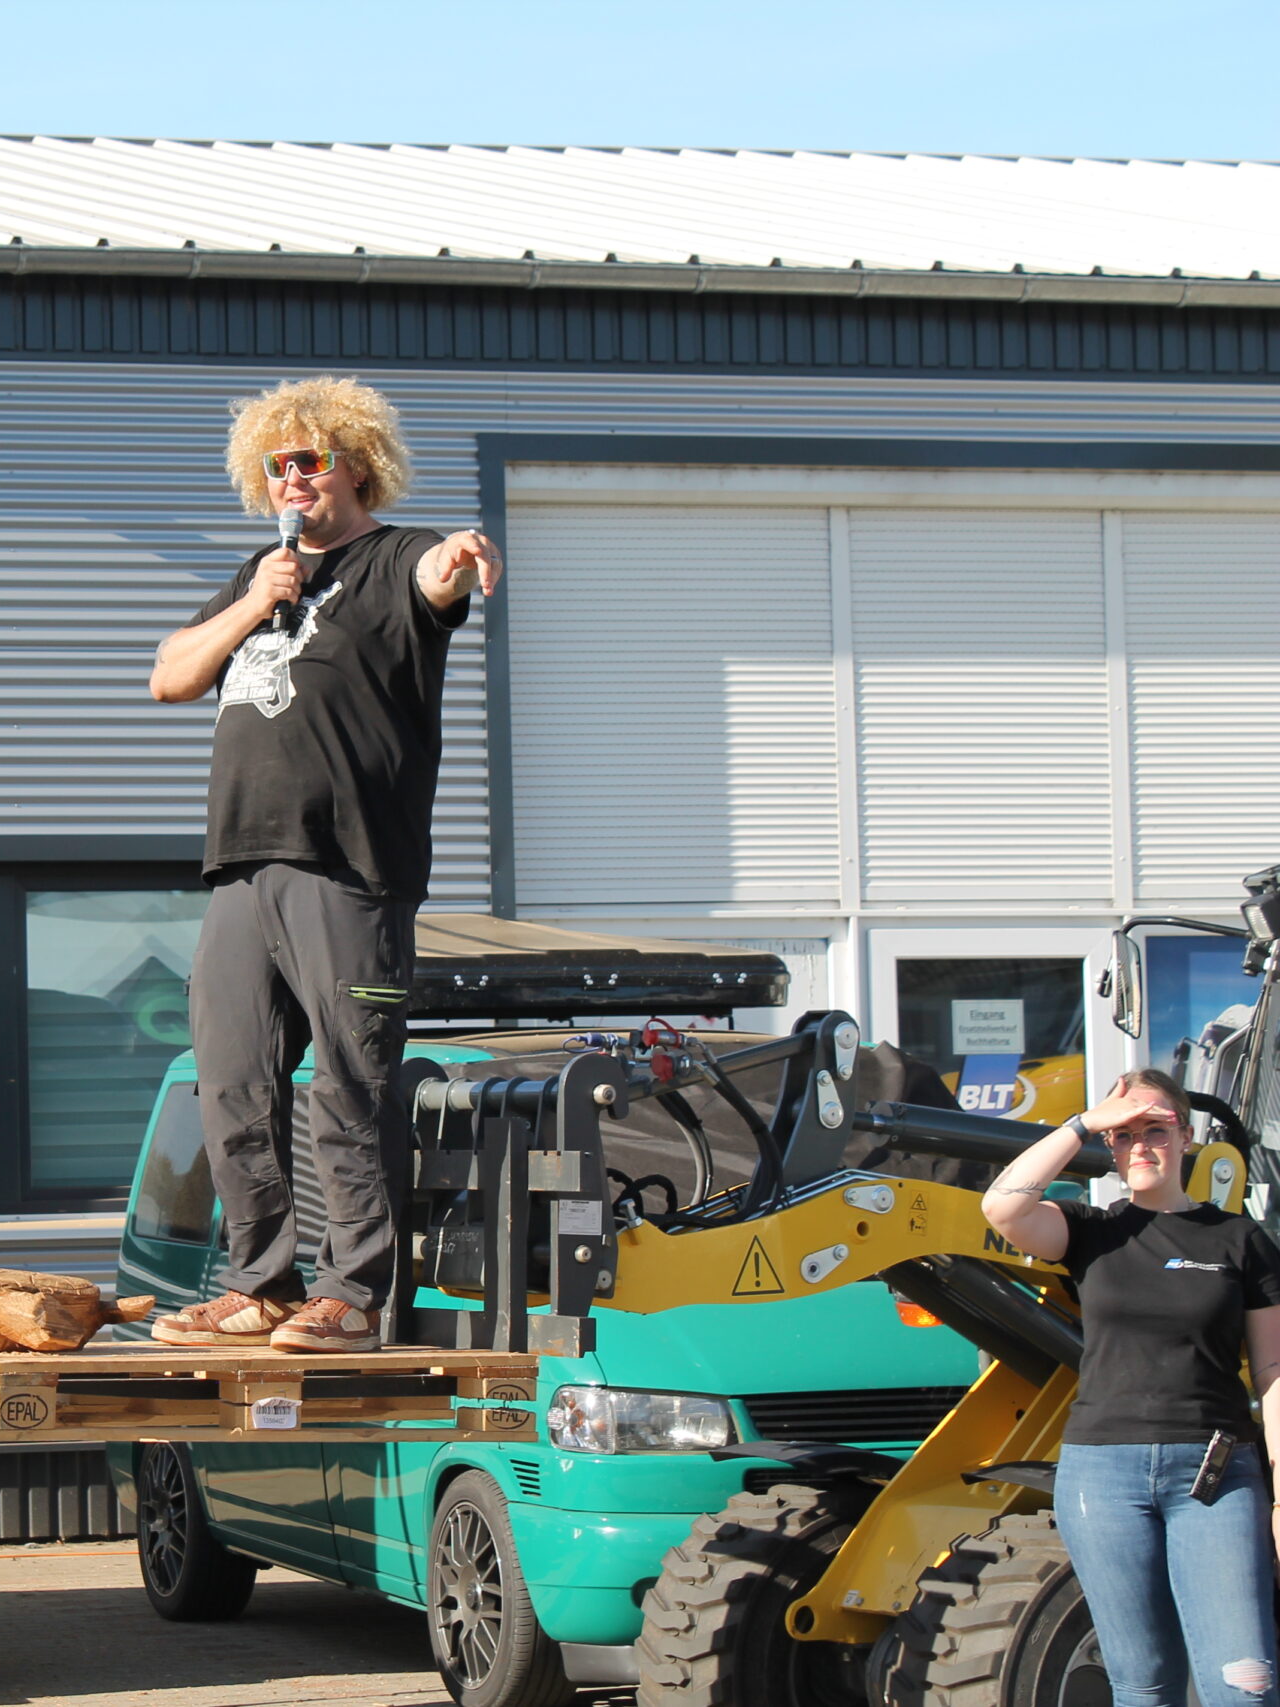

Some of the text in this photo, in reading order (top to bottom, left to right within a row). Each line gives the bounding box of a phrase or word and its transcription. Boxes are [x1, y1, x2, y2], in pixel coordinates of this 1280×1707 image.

[969, 1009, 1006, 1020] Eingang
[958, 1084, 1015, 1111] BLT
[7, 1401, 41, 1421] EPAL
